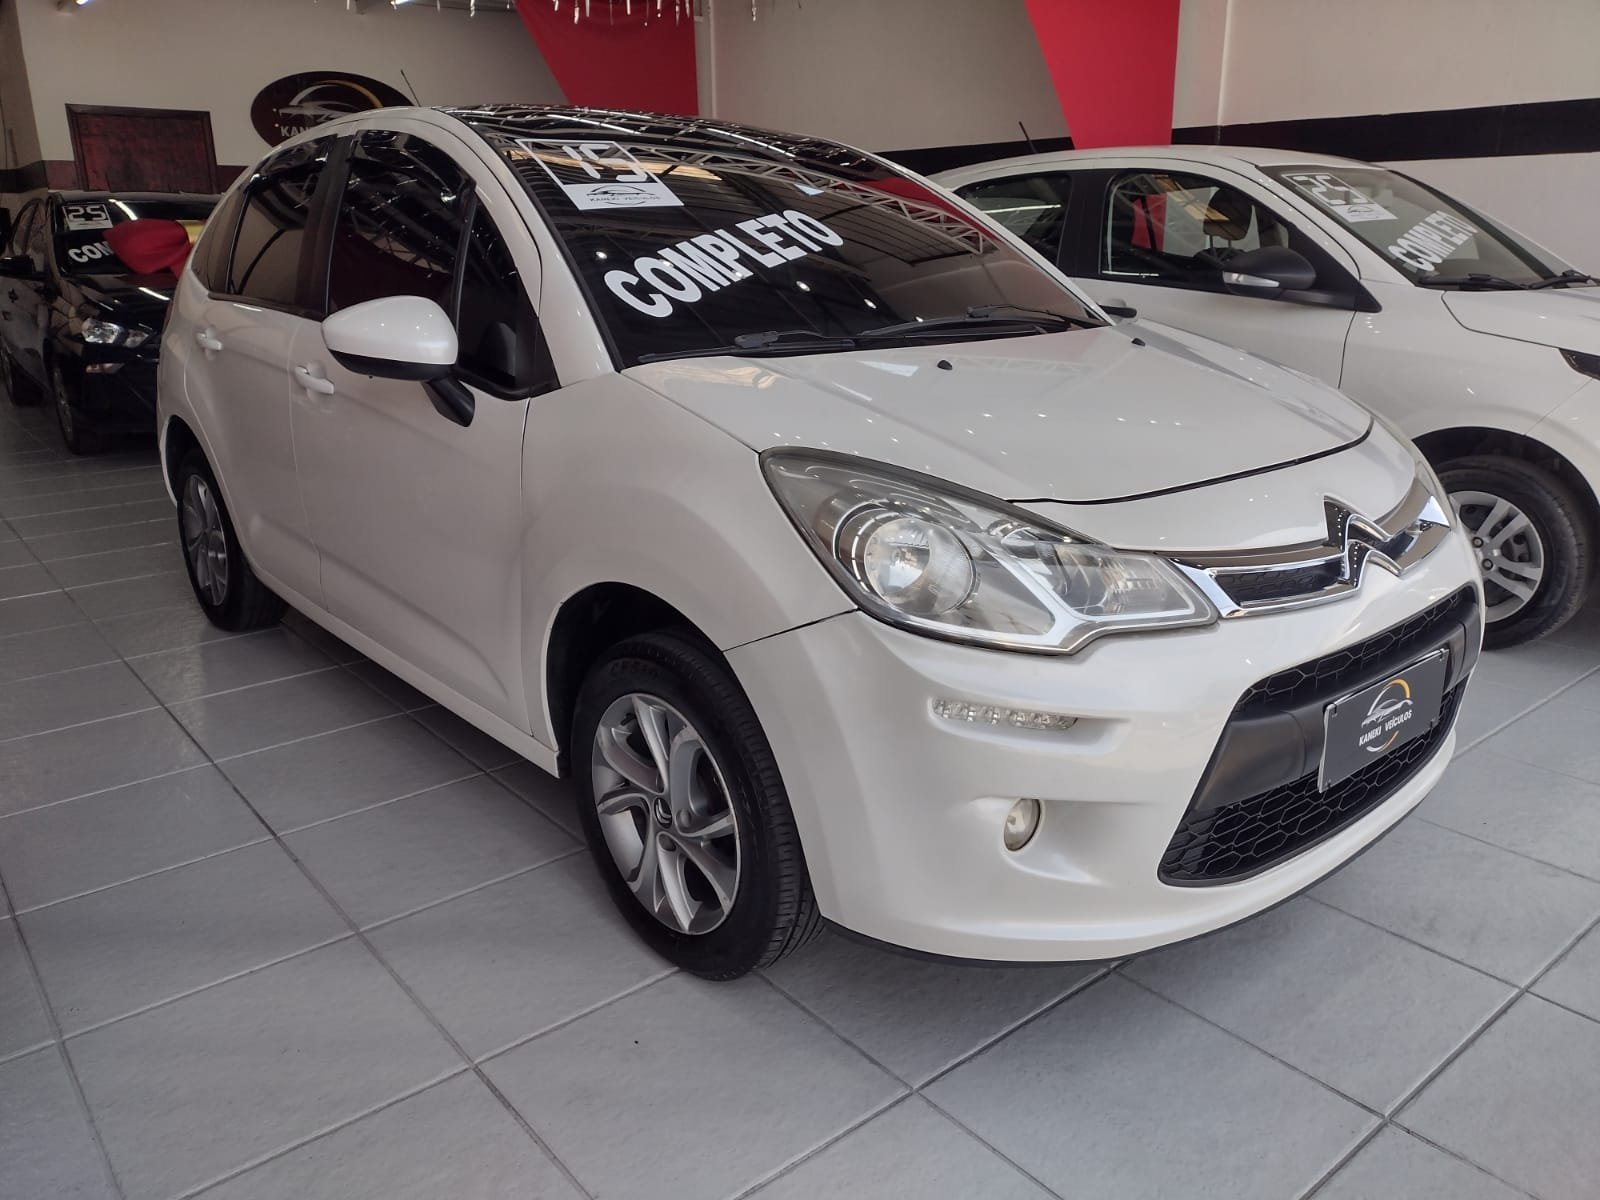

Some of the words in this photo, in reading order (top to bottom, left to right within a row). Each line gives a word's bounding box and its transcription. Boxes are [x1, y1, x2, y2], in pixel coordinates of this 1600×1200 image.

[67, 206, 106, 221] 25
[1388, 210, 1478, 271] COMPLETO
[604, 209, 843, 318] COMPLETO
[1359, 725, 1382, 746] KANEKI
